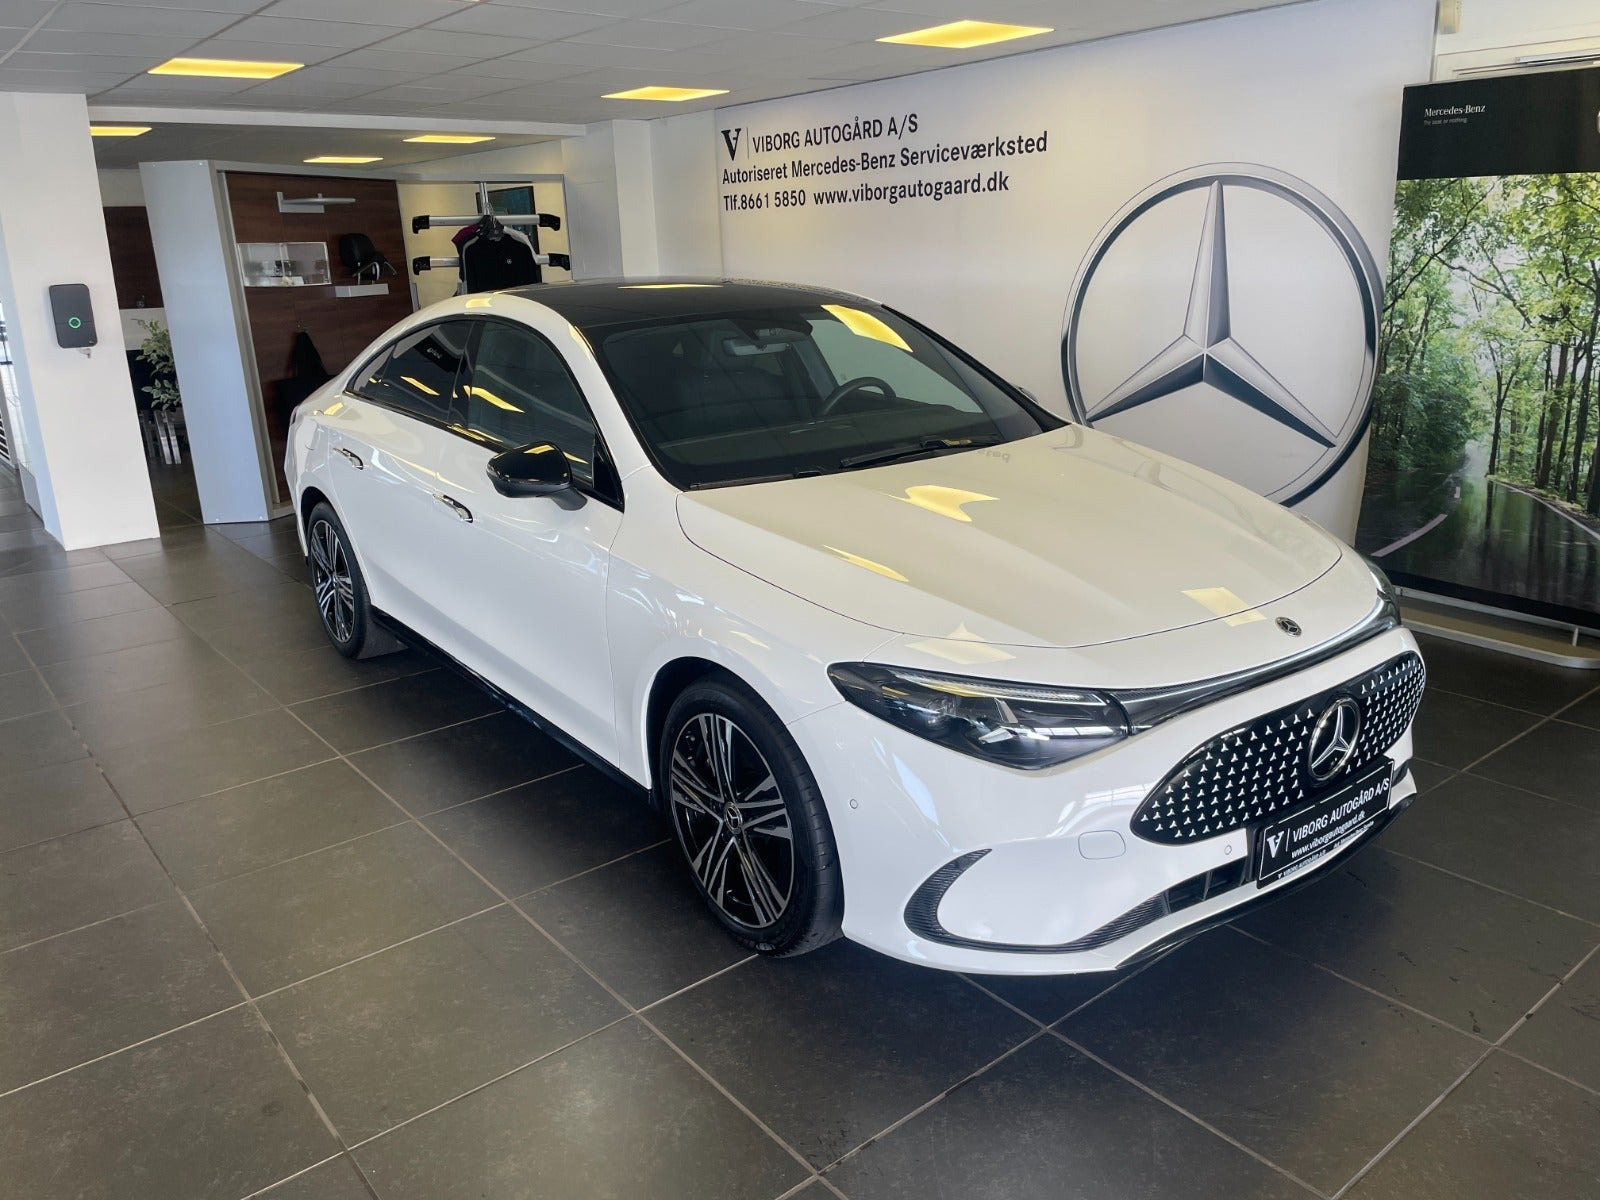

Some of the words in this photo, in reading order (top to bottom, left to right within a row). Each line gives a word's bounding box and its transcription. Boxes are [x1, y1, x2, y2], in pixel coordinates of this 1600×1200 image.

[1424, 104, 1486, 117] Mercedes-Benz
[753, 132, 800, 152] VIBORG
[804, 116, 883, 147] AUTOGÅRD
[887, 113, 918, 140] A/S
[722, 163, 788, 185] Autoriseret
[791, 152, 896, 178] Mercedes-Benz
[900, 130, 1048, 167] Serviceværksted
[723, 194, 770, 211] Tlf.8661
[774, 190, 806, 207] 5850
[813, 171, 1009, 205] www.viborgautogaard.dk
[1293, 814, 1328, 842] VIBORG
[1330, 787, 1374, 824] AUTOGÅRD
[1375, 778, 1390, 796] A/S
